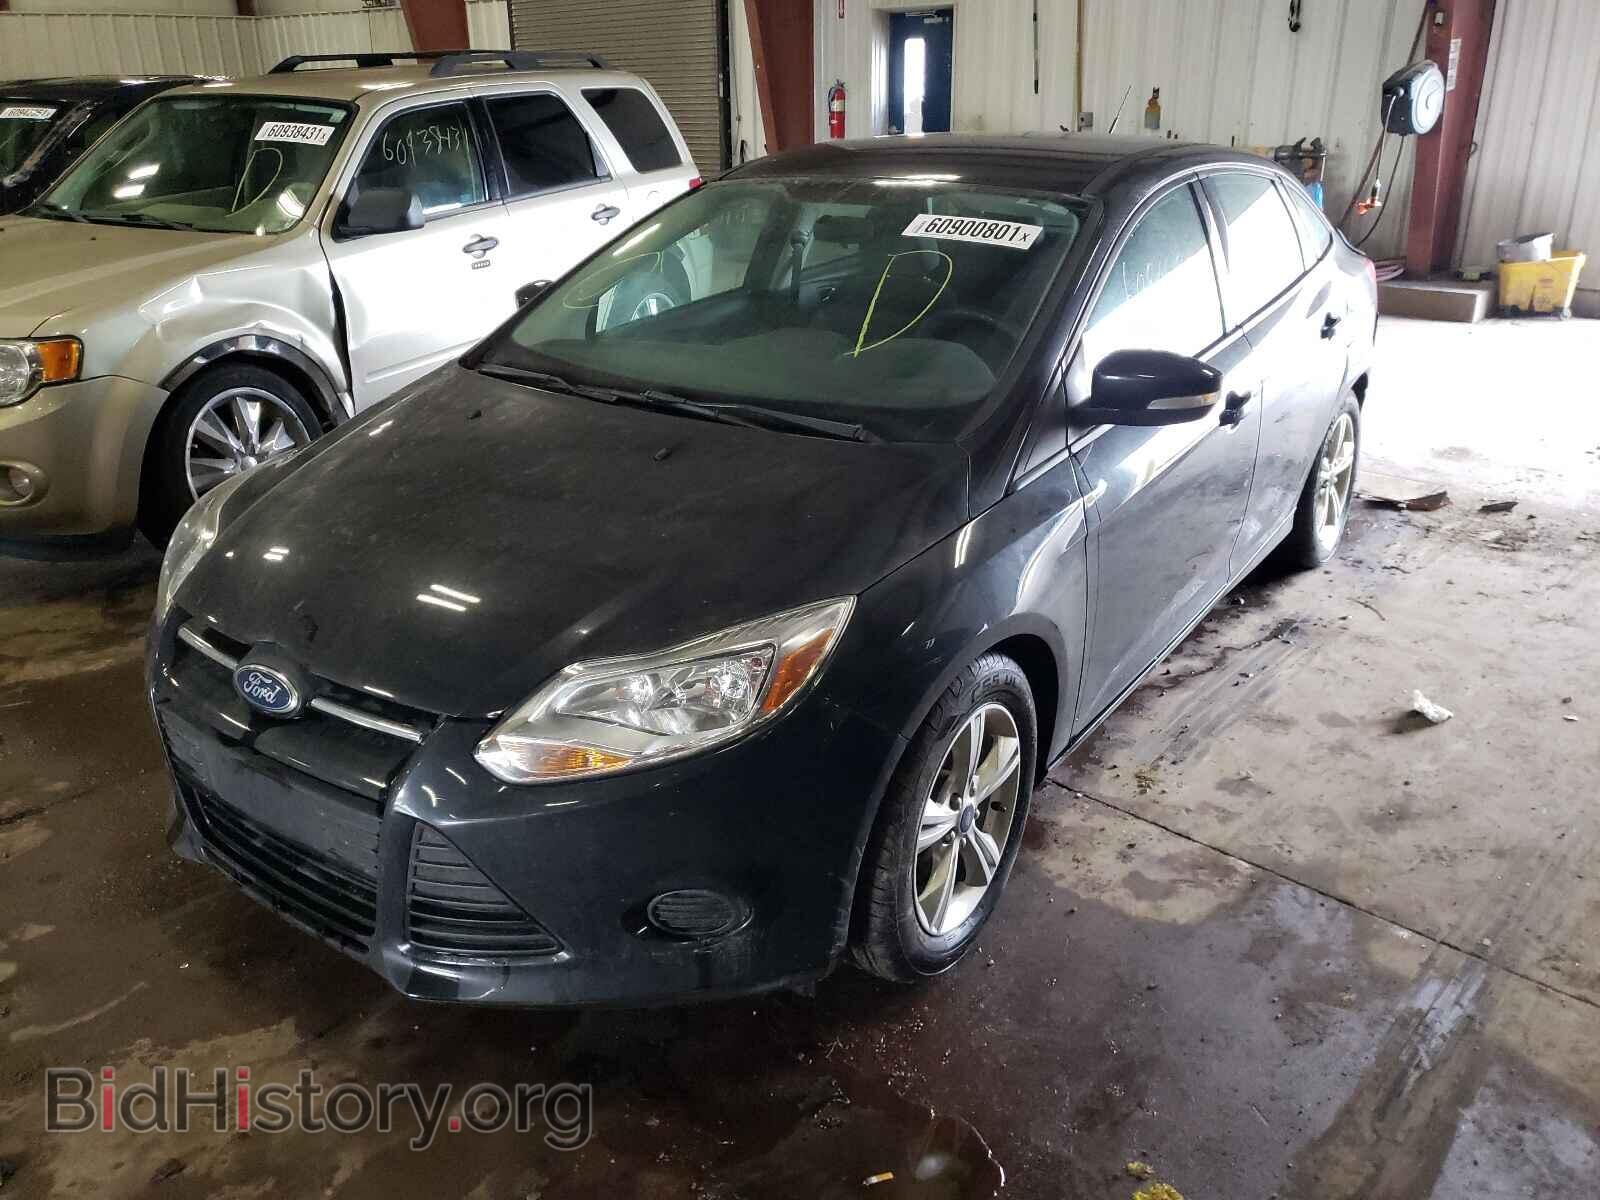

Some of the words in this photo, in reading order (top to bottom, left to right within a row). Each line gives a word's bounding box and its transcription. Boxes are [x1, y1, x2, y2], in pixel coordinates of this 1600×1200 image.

[267, 124, 322, 140] 60938431
[925, 217, 1022, 242] 60900801
[243, 672, 282, 703] Ford
